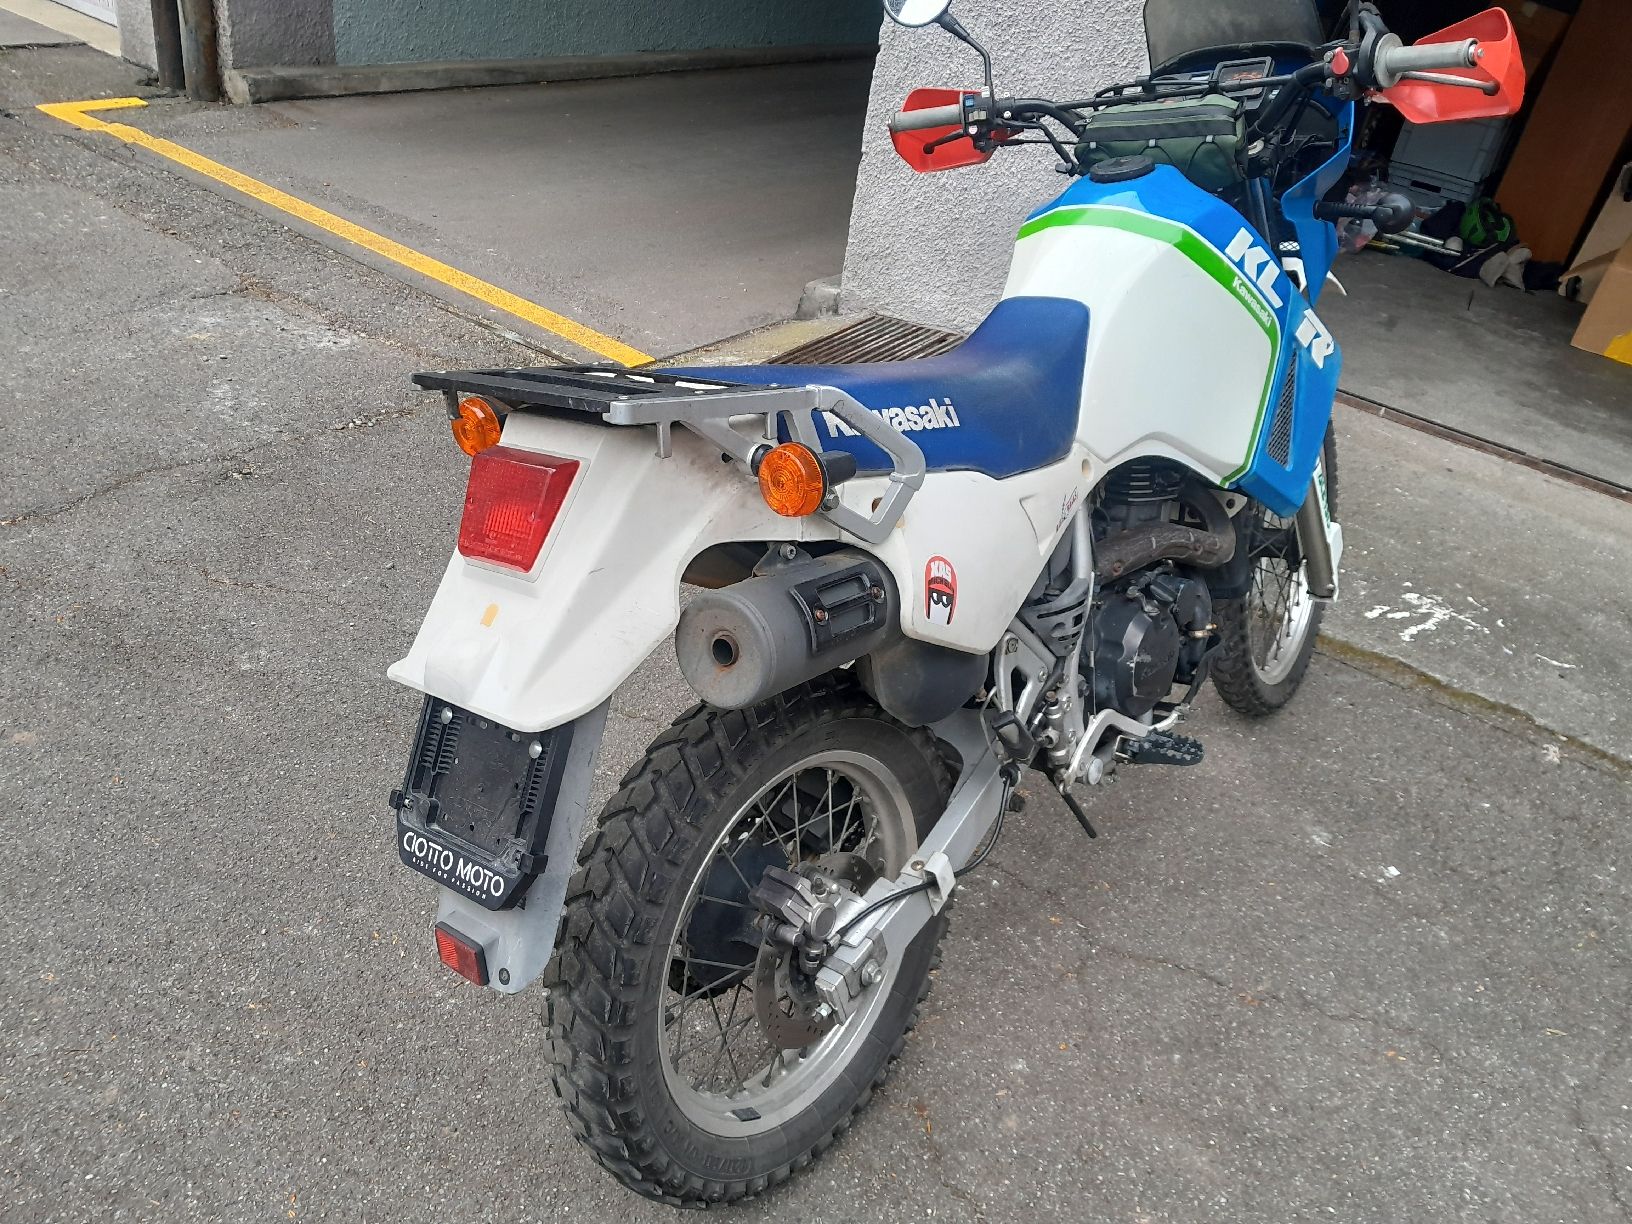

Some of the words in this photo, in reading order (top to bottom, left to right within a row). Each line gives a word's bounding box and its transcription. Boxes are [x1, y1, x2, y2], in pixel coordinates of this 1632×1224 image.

[1232, 276, 1273, 328] Kawasaki
[403, 831, 454, 871] CIOTTO
[456, 857, 505, 897] MOTO
[432, 867, 448, 879] FOR
[452, 877, 487, 900] PASSION
